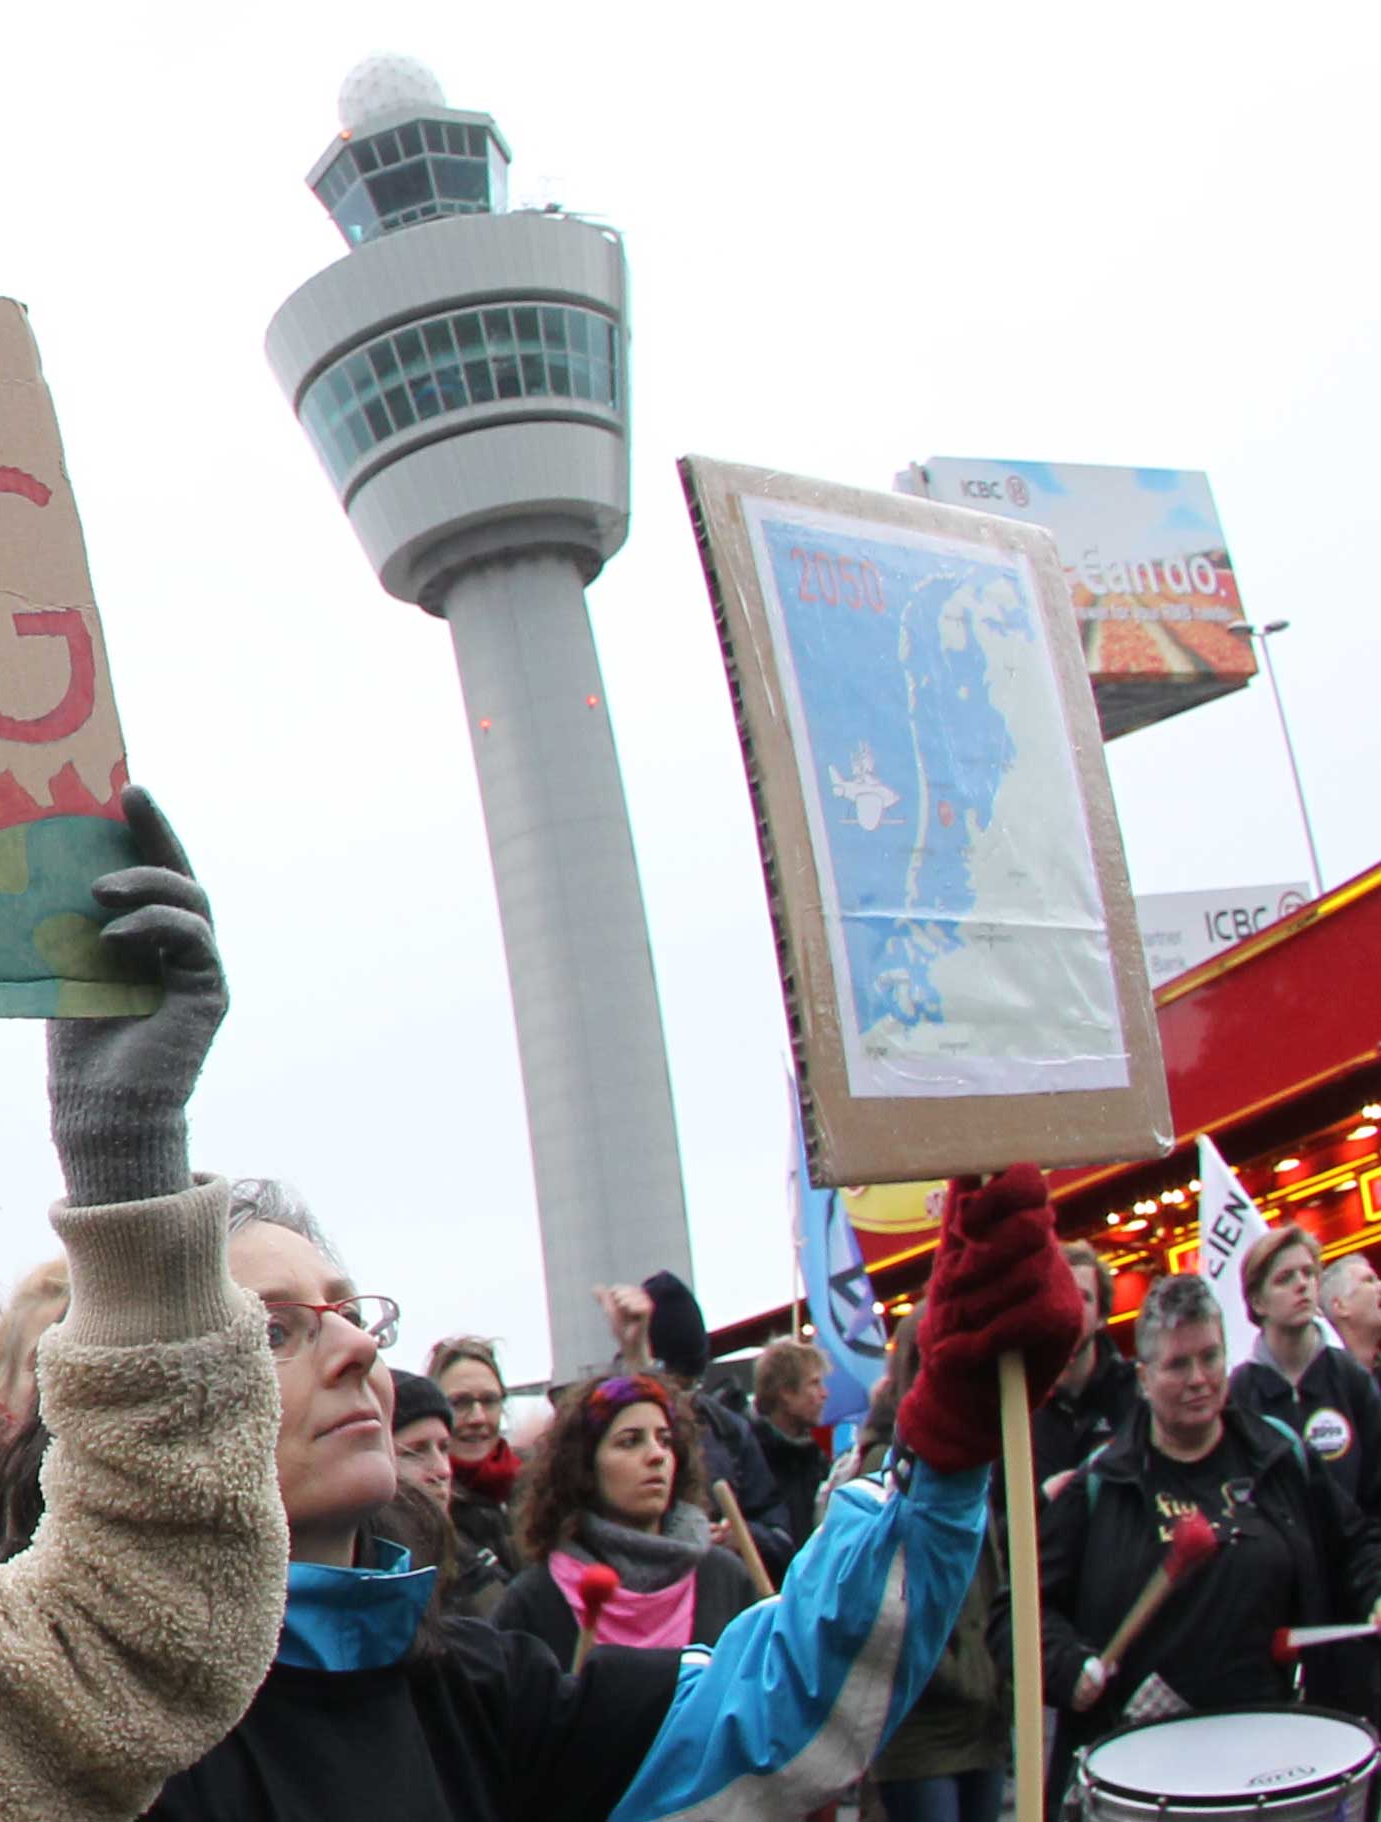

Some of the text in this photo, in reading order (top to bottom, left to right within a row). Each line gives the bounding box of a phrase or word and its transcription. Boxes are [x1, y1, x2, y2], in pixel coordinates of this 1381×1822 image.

[959, 479, 1003, 500] ICBC
[790, 547, 887, 614] 2050
[1203, 906, 1268, 943] ICBC
